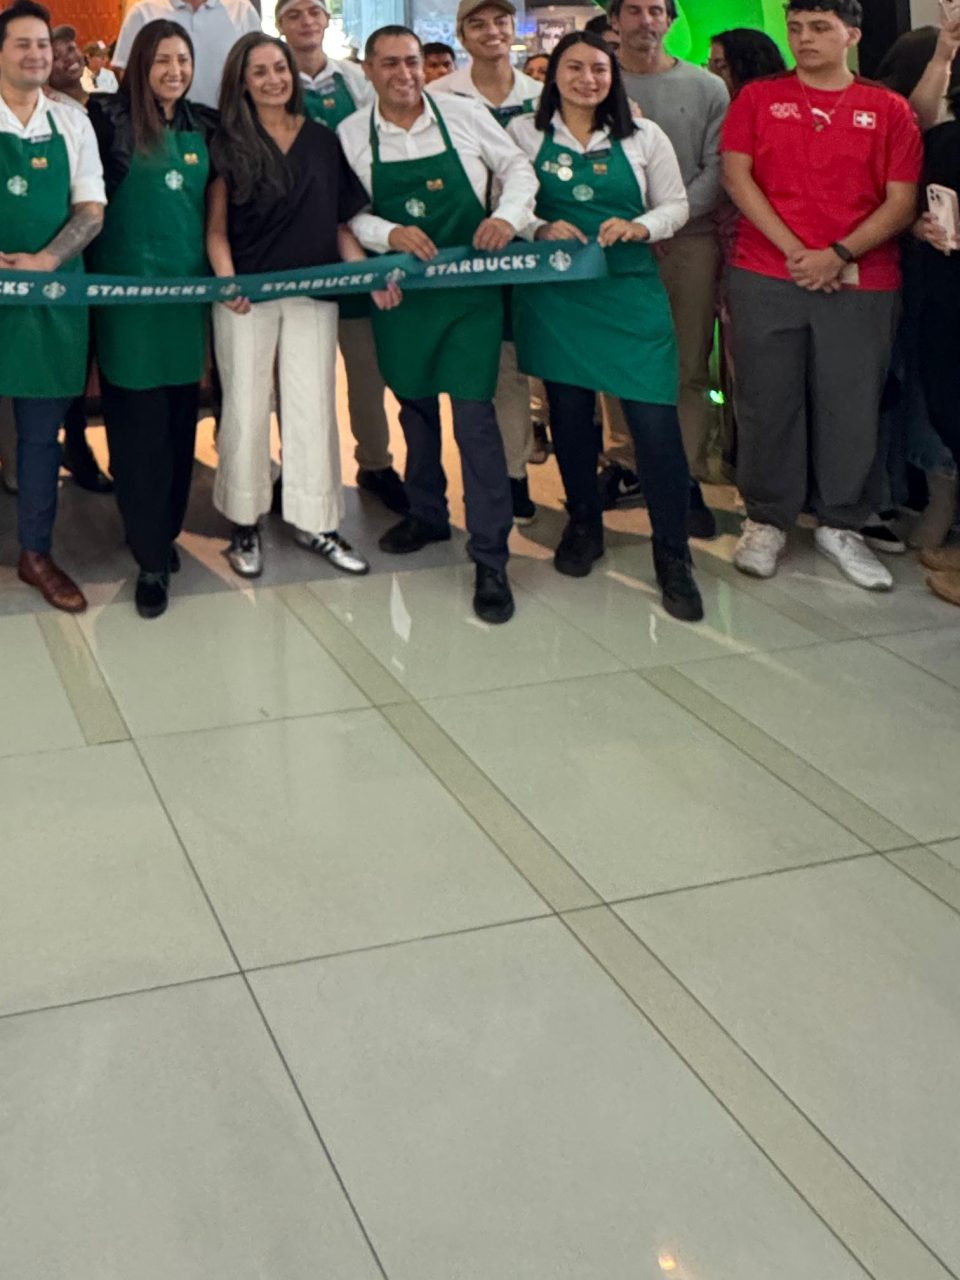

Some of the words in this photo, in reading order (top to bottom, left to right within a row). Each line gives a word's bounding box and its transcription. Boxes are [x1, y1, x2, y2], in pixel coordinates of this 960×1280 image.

[86, 285, 207, 296] STARBUCKS
[261, 274, 373, 292] STARBUCKS
[425, 255, 537, 277] STARBUCKS
